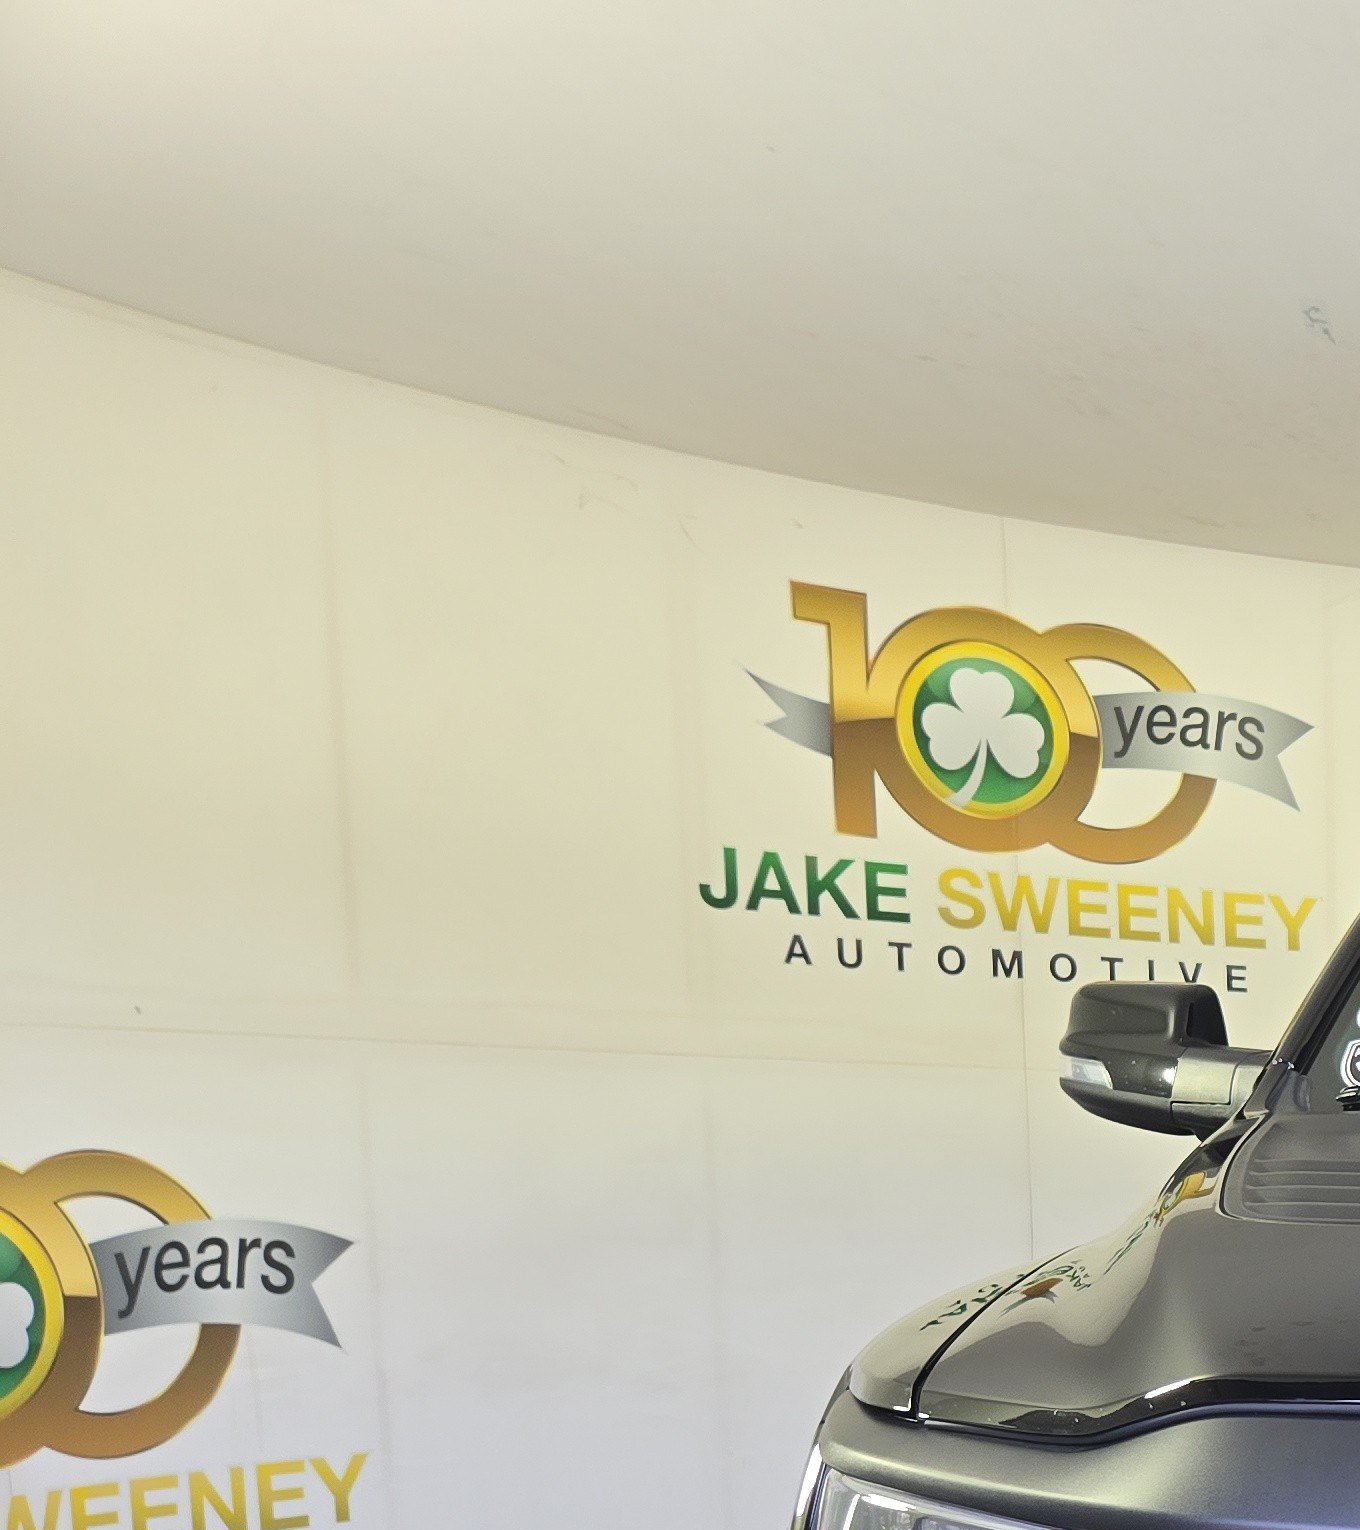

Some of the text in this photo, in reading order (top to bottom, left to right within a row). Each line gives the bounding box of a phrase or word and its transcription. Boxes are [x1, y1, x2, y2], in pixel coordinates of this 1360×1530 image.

[790, 579, 1266, 865] 100 years
[698, 845, 1318, 952] JAKE SWEENEY
[784, 933, 1249, 993] AUTOMOTIVE
[113, 1234, 297, 1319] years
